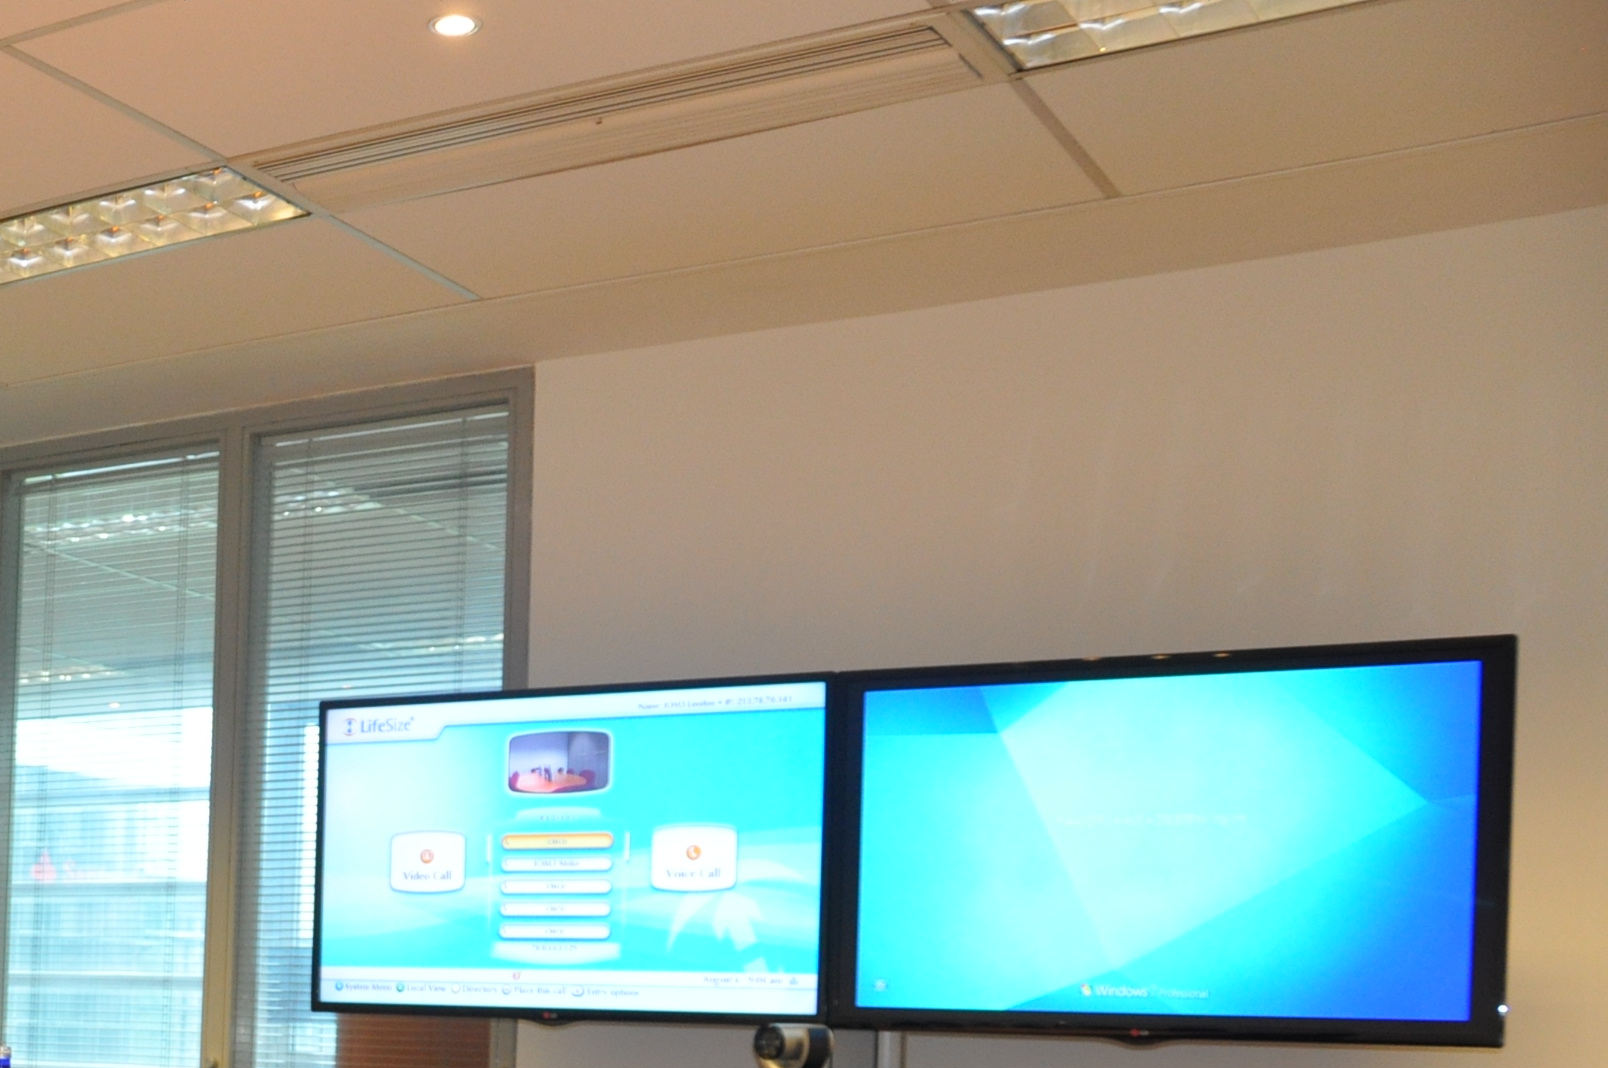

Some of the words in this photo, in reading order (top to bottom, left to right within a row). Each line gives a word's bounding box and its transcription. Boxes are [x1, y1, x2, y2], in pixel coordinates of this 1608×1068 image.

[360, 717, 411, 733] LifeSize
[403, 871, 430, 880] Video
[433, 870, 452, 880] Call
[666, 869, 695, 878] Voice
[700, 868, 721, 878] Call
[429, 984, 446, 992] View
[1095, 985, 1149, 997] Windows
